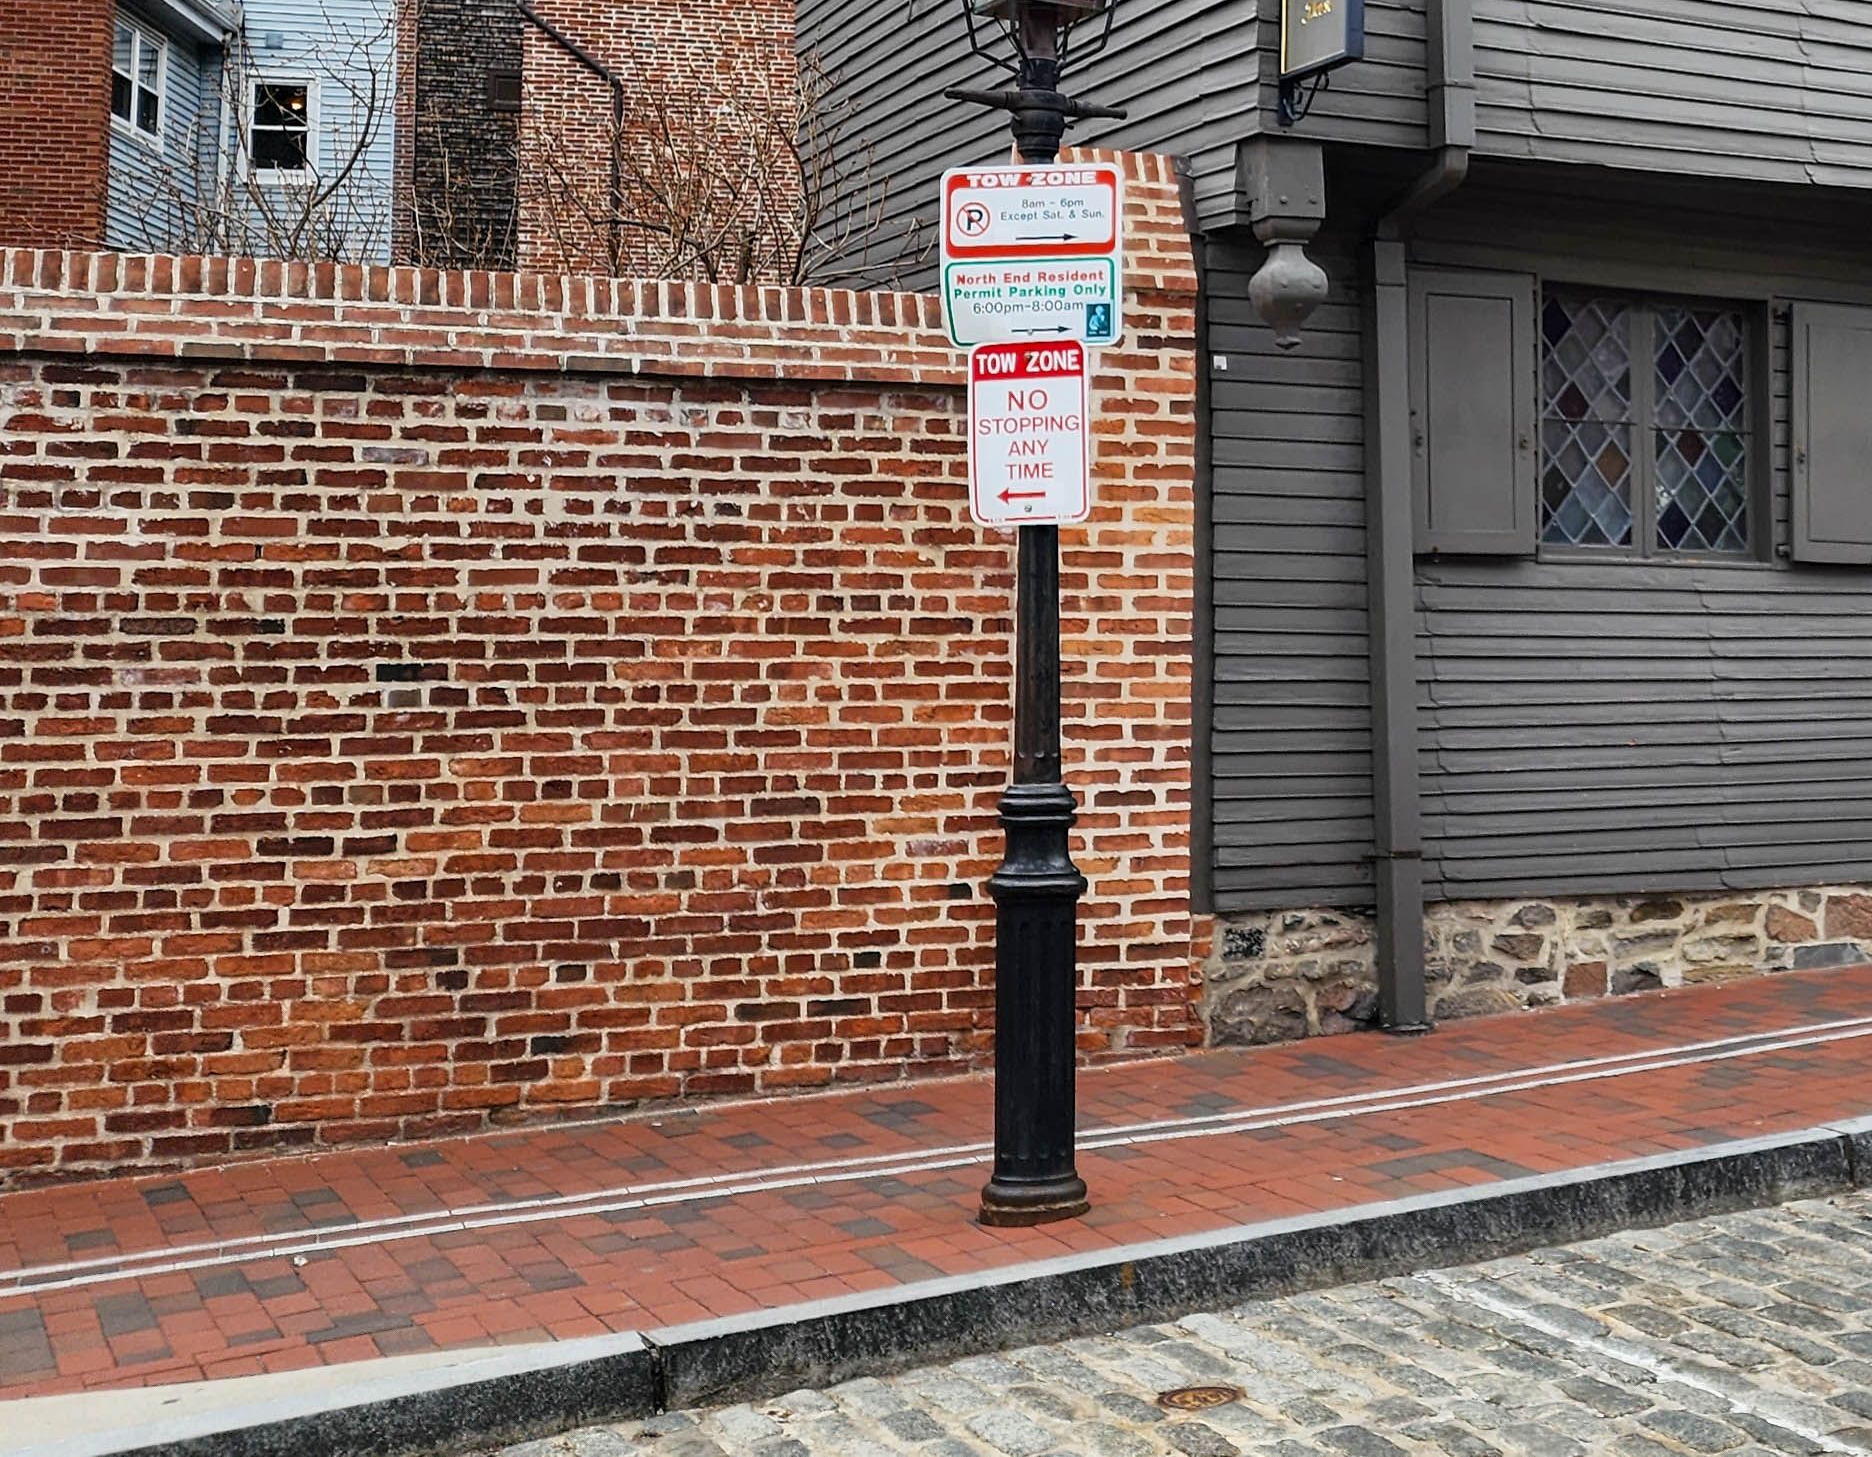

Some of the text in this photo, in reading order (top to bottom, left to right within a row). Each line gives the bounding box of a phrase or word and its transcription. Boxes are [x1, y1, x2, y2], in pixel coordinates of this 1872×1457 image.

[967, 171, 1097, 188] TOW ZONE
[1022, 199, 1045, 208] 8am
[1060, 198, 1084, 208] 6pm
[1000, 209, 1105, 222] Except Sat. & Sun.
[956, 270, 1104, 285] North End Resident
[954, 284, 1106, 300] Permit Parking Only
[973, 300, 1084, 315] 6:00pm-8:00am
[975, 349, 1081, 375] TOW ZONE
[1008, 389, 1048, 411] NO
[978, 415, 1080, 435] STOPPING
[1008, 439, 1049, 457] ANY
[1005, 462, 1054, 480] TIME
